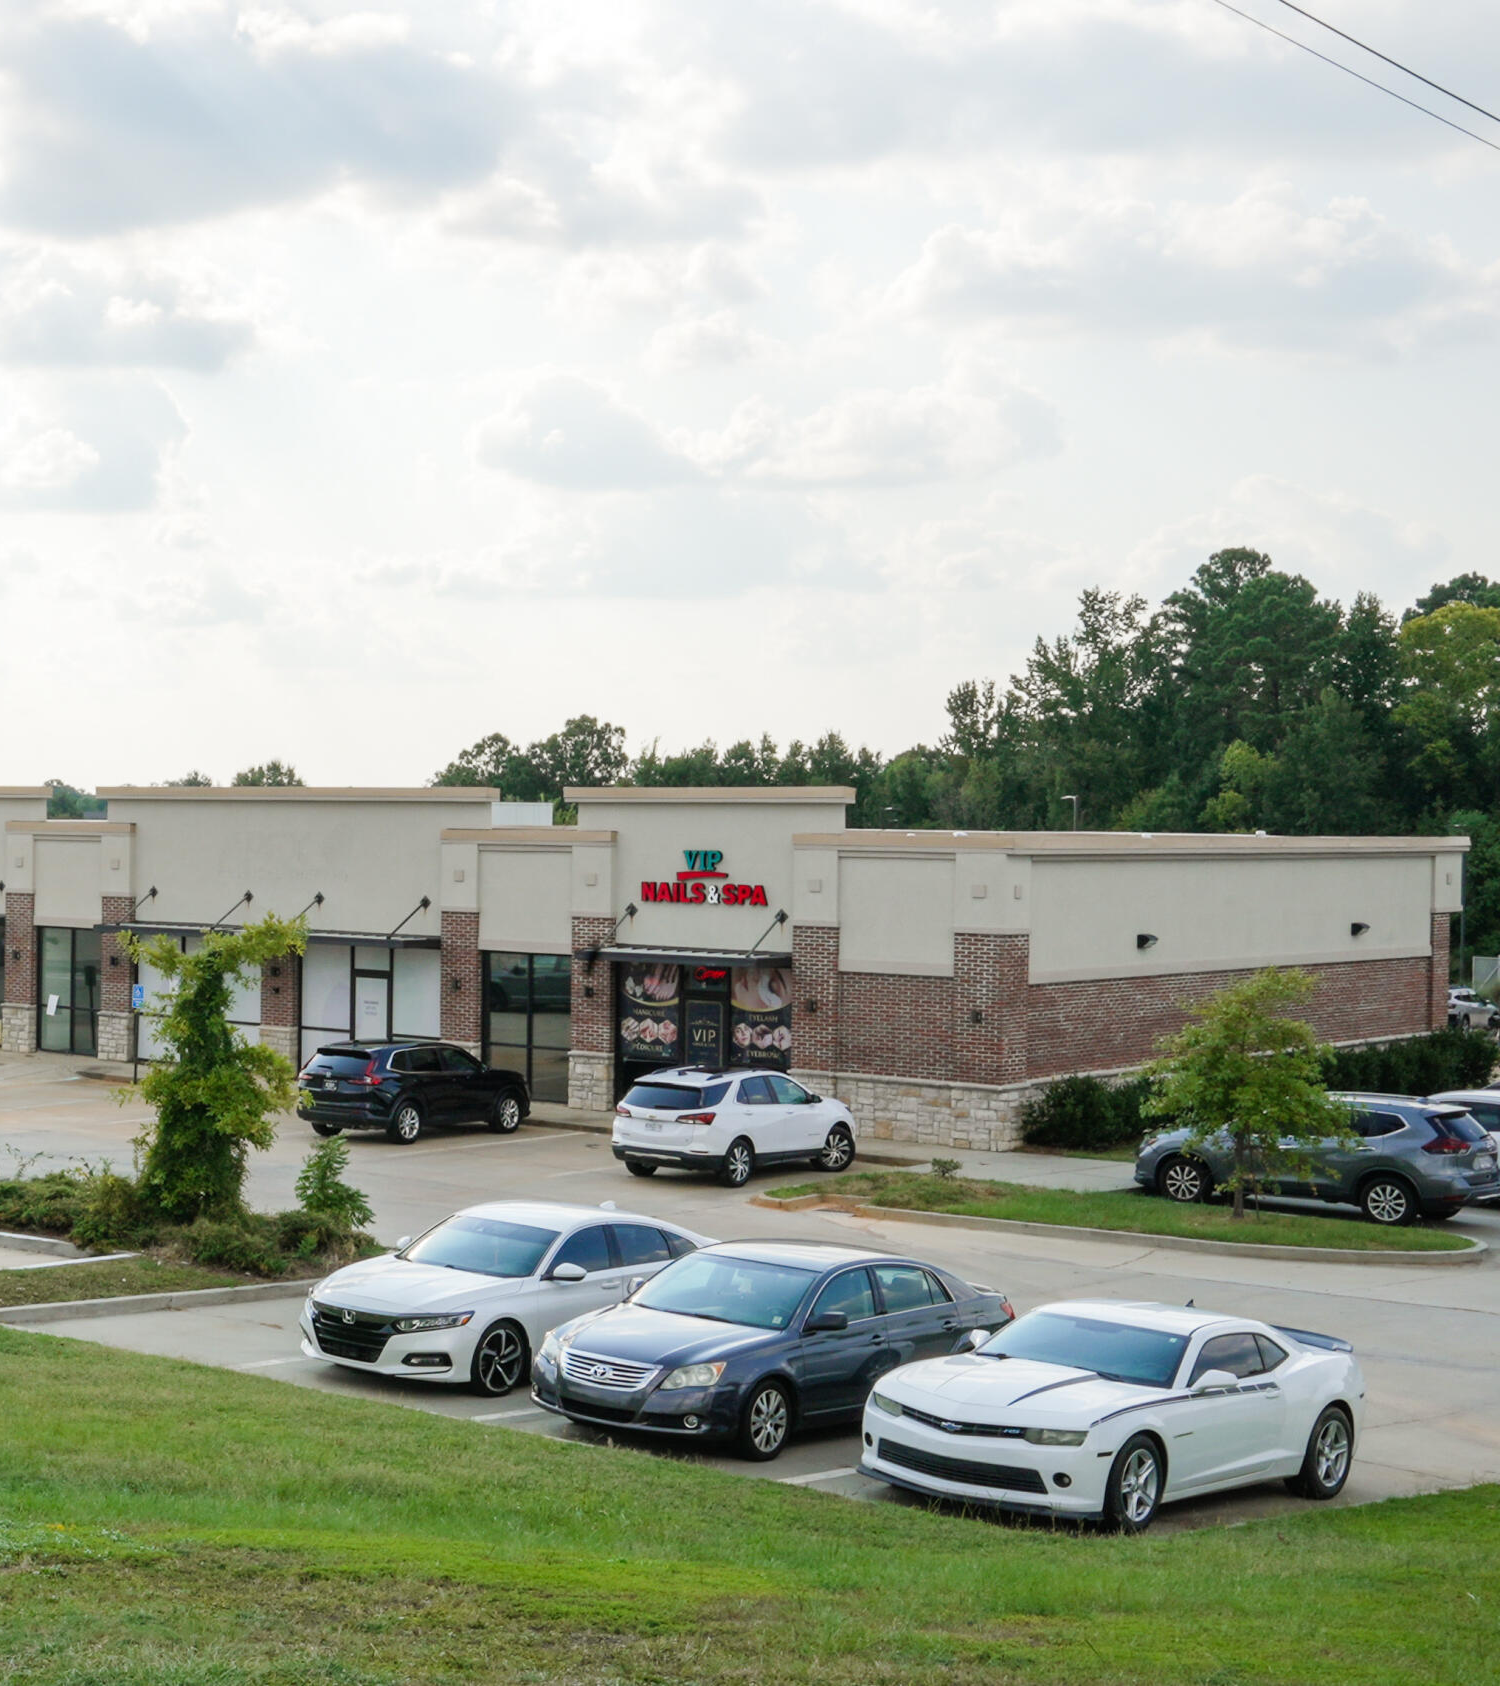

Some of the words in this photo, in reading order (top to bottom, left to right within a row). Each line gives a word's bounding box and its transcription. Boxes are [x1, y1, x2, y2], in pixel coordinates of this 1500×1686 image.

[683, 850, 723, 871] VIP
[641, 881, 706, 904] NAILS
[722, 883, 768, 906] SPA
[693, 1029, 716, 1042] VIP
